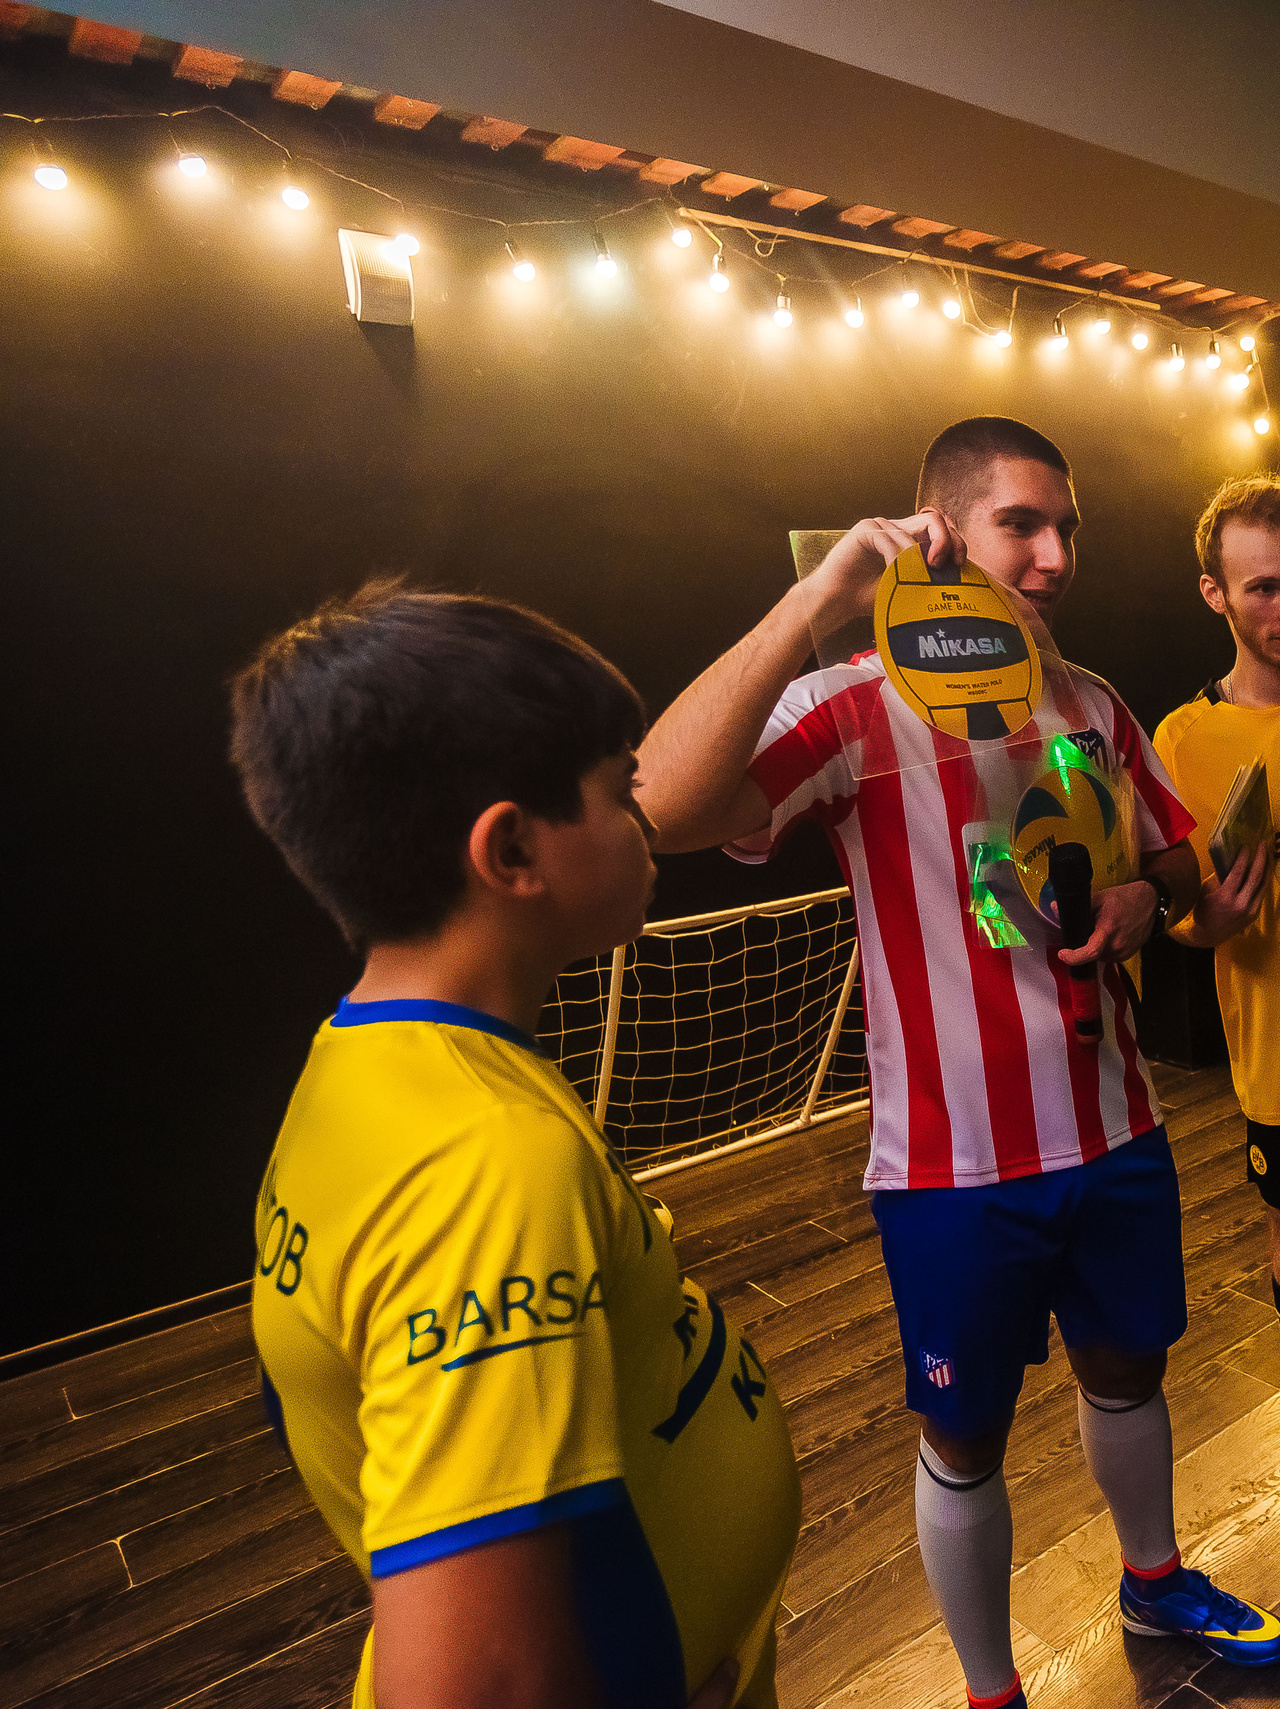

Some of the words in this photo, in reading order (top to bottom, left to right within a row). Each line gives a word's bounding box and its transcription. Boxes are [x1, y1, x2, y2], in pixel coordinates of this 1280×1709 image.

[927, 602, 954, 613] GAME
[955, 602, 980, 613] BALL
[260, 1206, 309, 1296] OB
